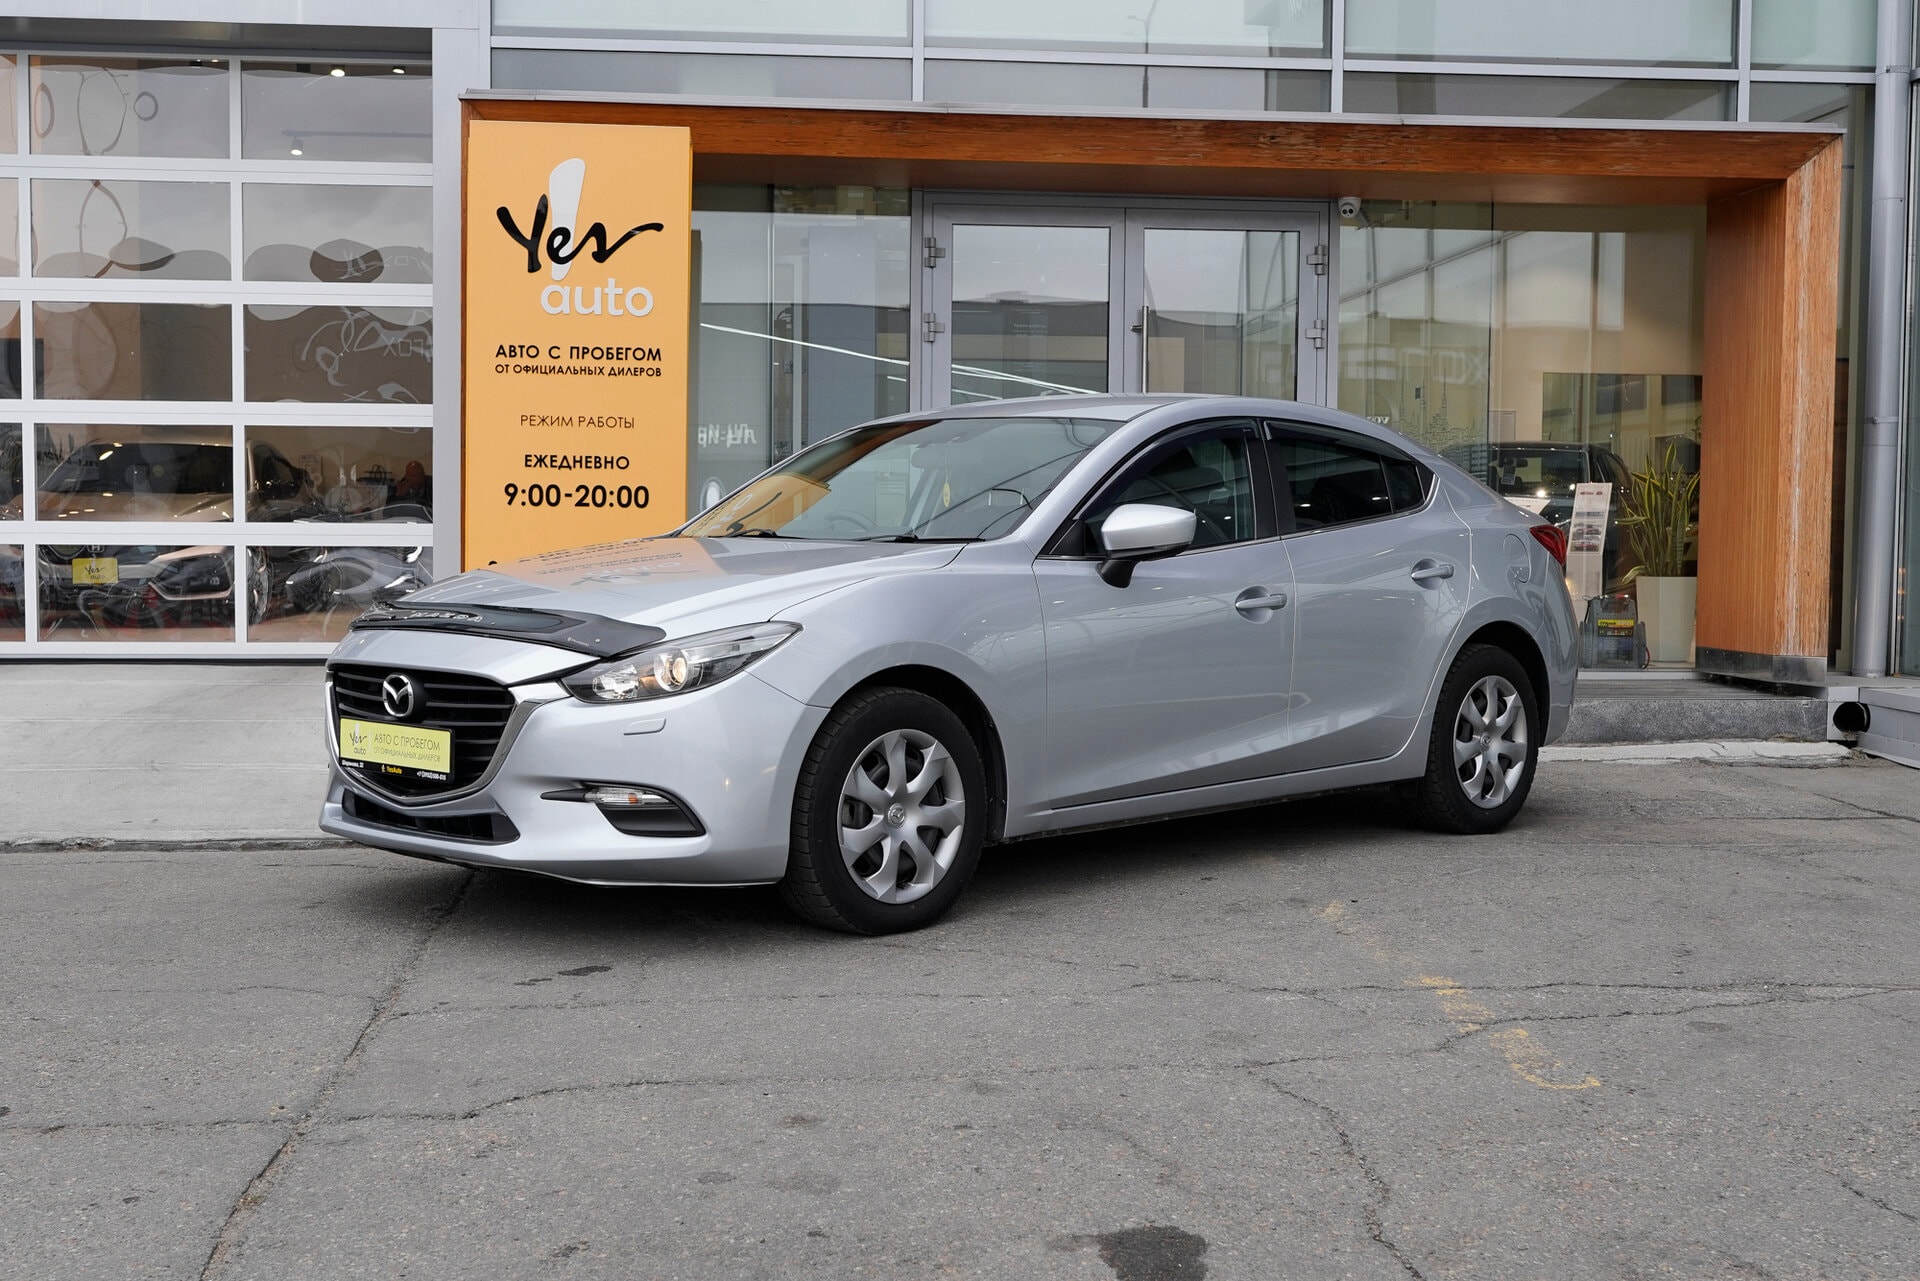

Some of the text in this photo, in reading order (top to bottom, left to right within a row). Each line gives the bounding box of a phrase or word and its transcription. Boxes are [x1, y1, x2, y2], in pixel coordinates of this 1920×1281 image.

[496, 193, 664, 273] Yes
[540, 278, 654, 316] auto
[495, 344, 662, 361] АВТО С ПРОБЕГОМ
[495, 364, 662, 377] ОТ ОФИЦИАЛЬНЫХ ДИЛЕРОВ
[520, 414, 635, 429] РЕЖИМ РАБОТЫ
[524, 454, 630, 470] ЕЖЕДНЕВНО
[504, 483, 650, 509] 9:00-20:00
[374, 733, 393, 745] АВТО
[400, 736, 441, 751] ПРОБЕГОМ
